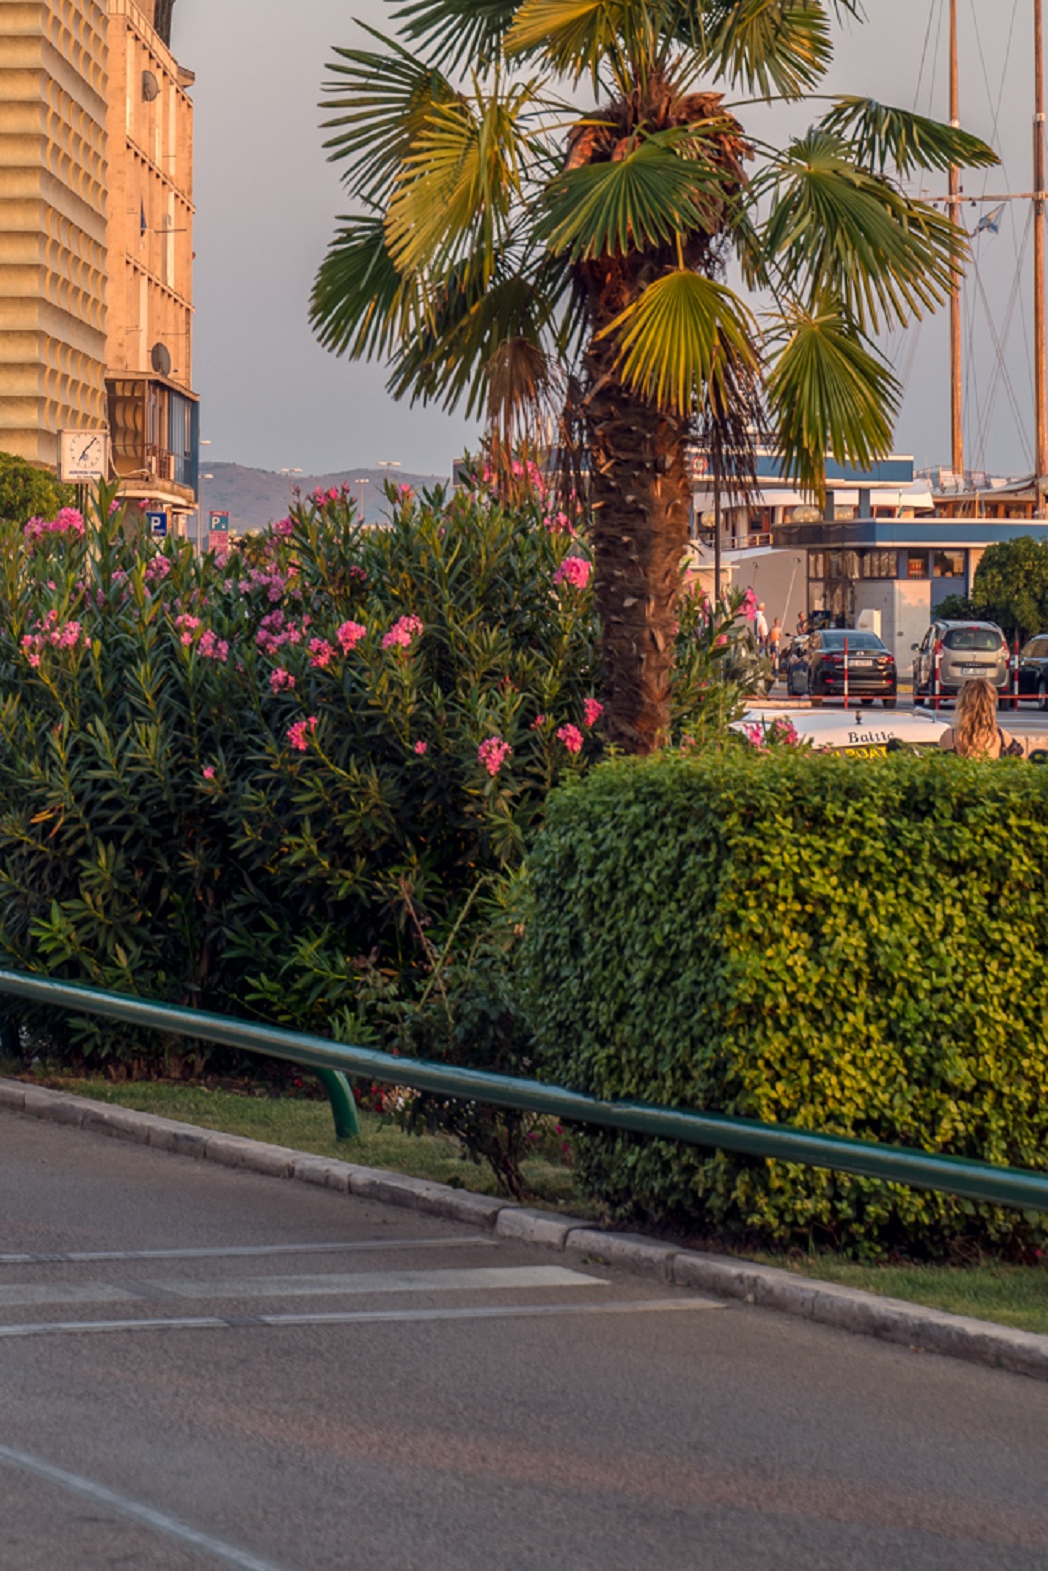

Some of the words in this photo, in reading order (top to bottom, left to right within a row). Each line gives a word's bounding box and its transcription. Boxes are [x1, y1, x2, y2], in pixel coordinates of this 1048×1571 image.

[151, 516, 161, 531] P
[211, 516, 220, 529] P
[848, 731, 894, 743] Baltic
